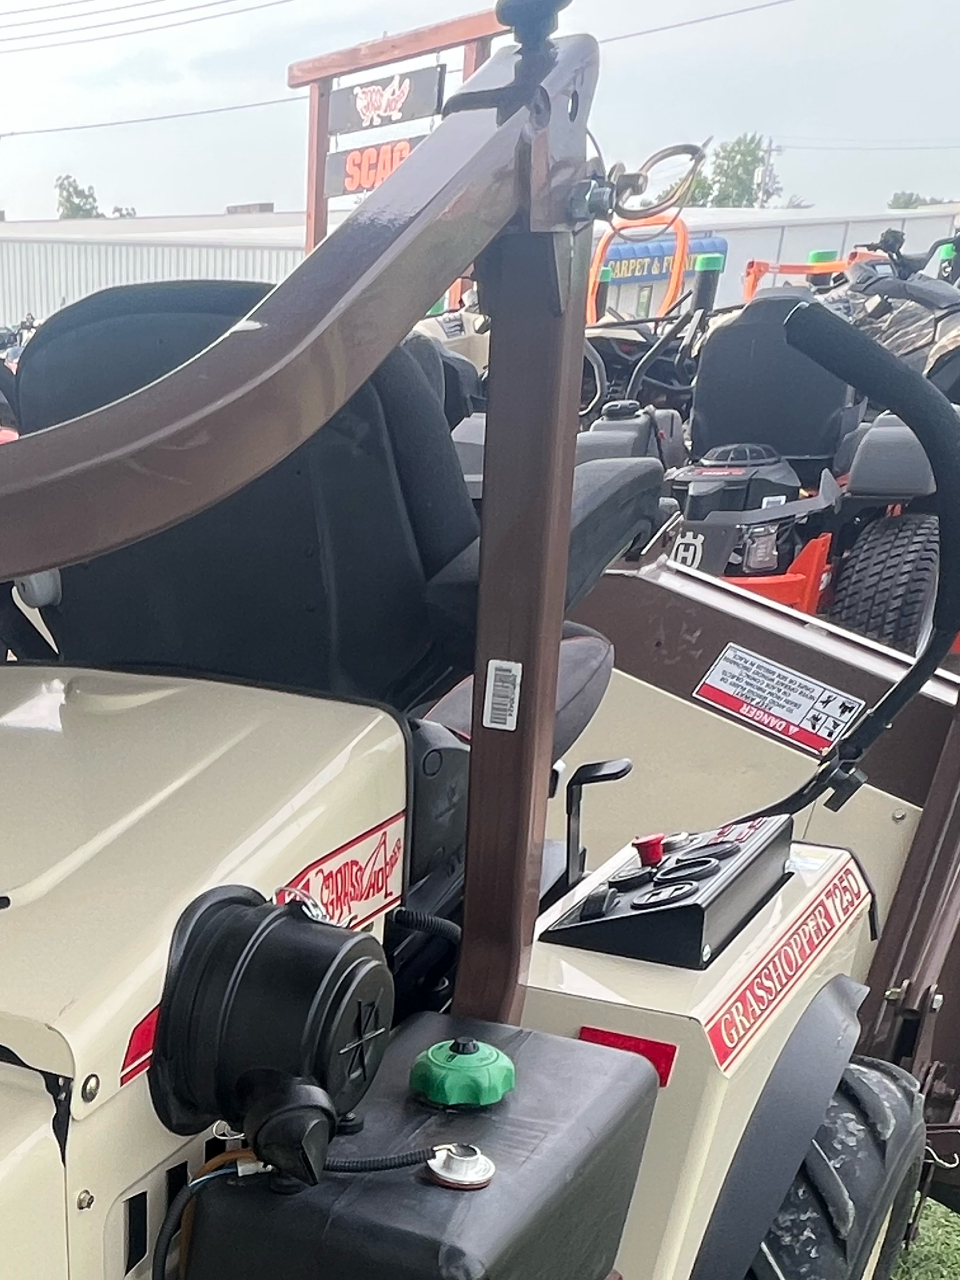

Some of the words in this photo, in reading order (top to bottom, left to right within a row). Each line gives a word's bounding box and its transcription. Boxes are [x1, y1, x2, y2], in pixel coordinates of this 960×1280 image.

[345, 141, 410, 191] SCAG
[608, 258, 650, 278] CARPET
[651, 260, 660, 275] &
[738, 703, 786, 731] DANGER
[315, 830, 402, 926] GRASSHOPPER
[720, 904, 830, 1048] GRASSHOPPER
[825, 868, 861, 922] 725D
